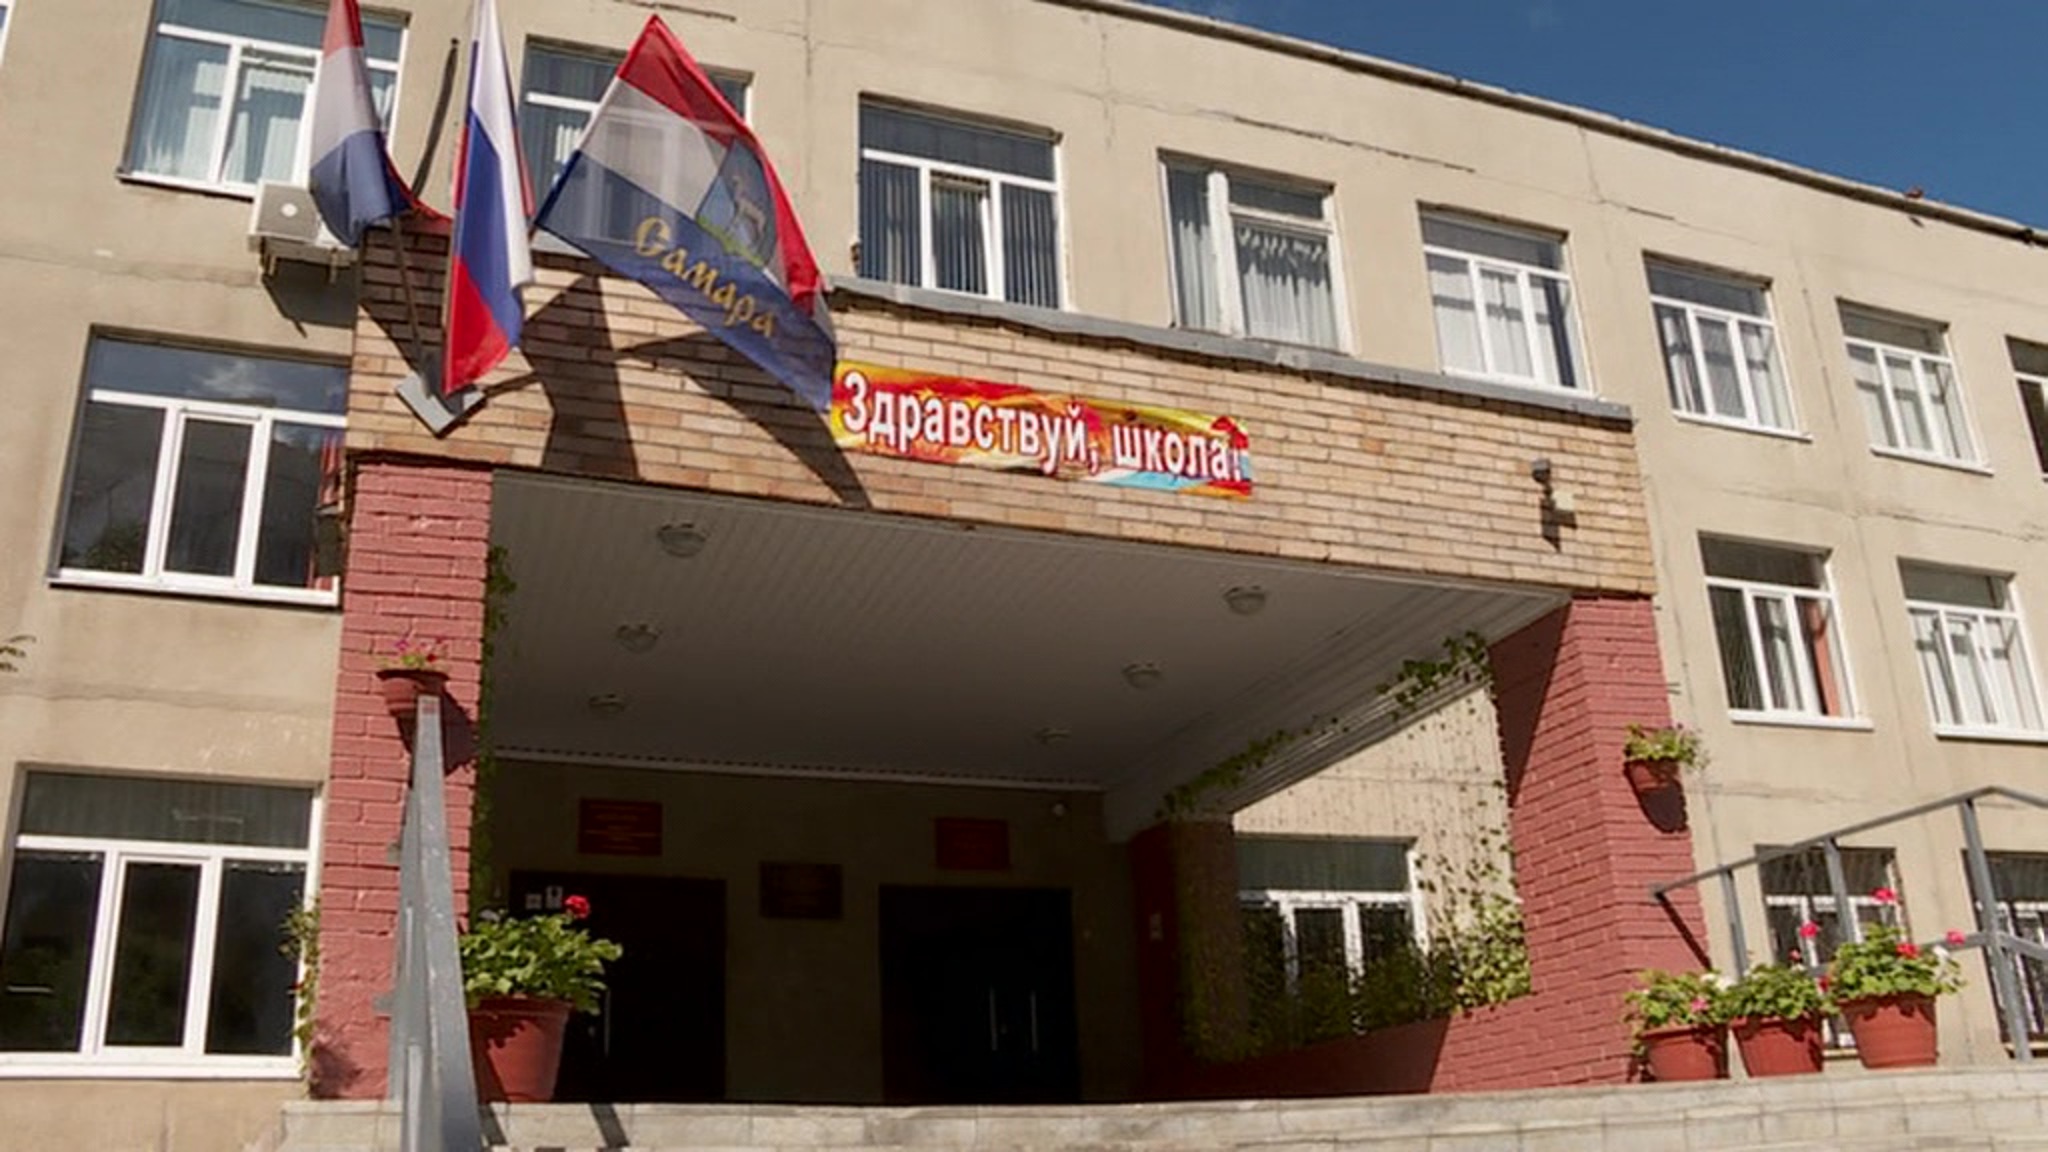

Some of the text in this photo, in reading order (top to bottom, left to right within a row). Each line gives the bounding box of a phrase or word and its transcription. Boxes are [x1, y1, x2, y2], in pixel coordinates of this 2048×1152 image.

[636, 216, 777, 338] Самара
[843, 371, 1241, 482] Здравствуй, школа!
